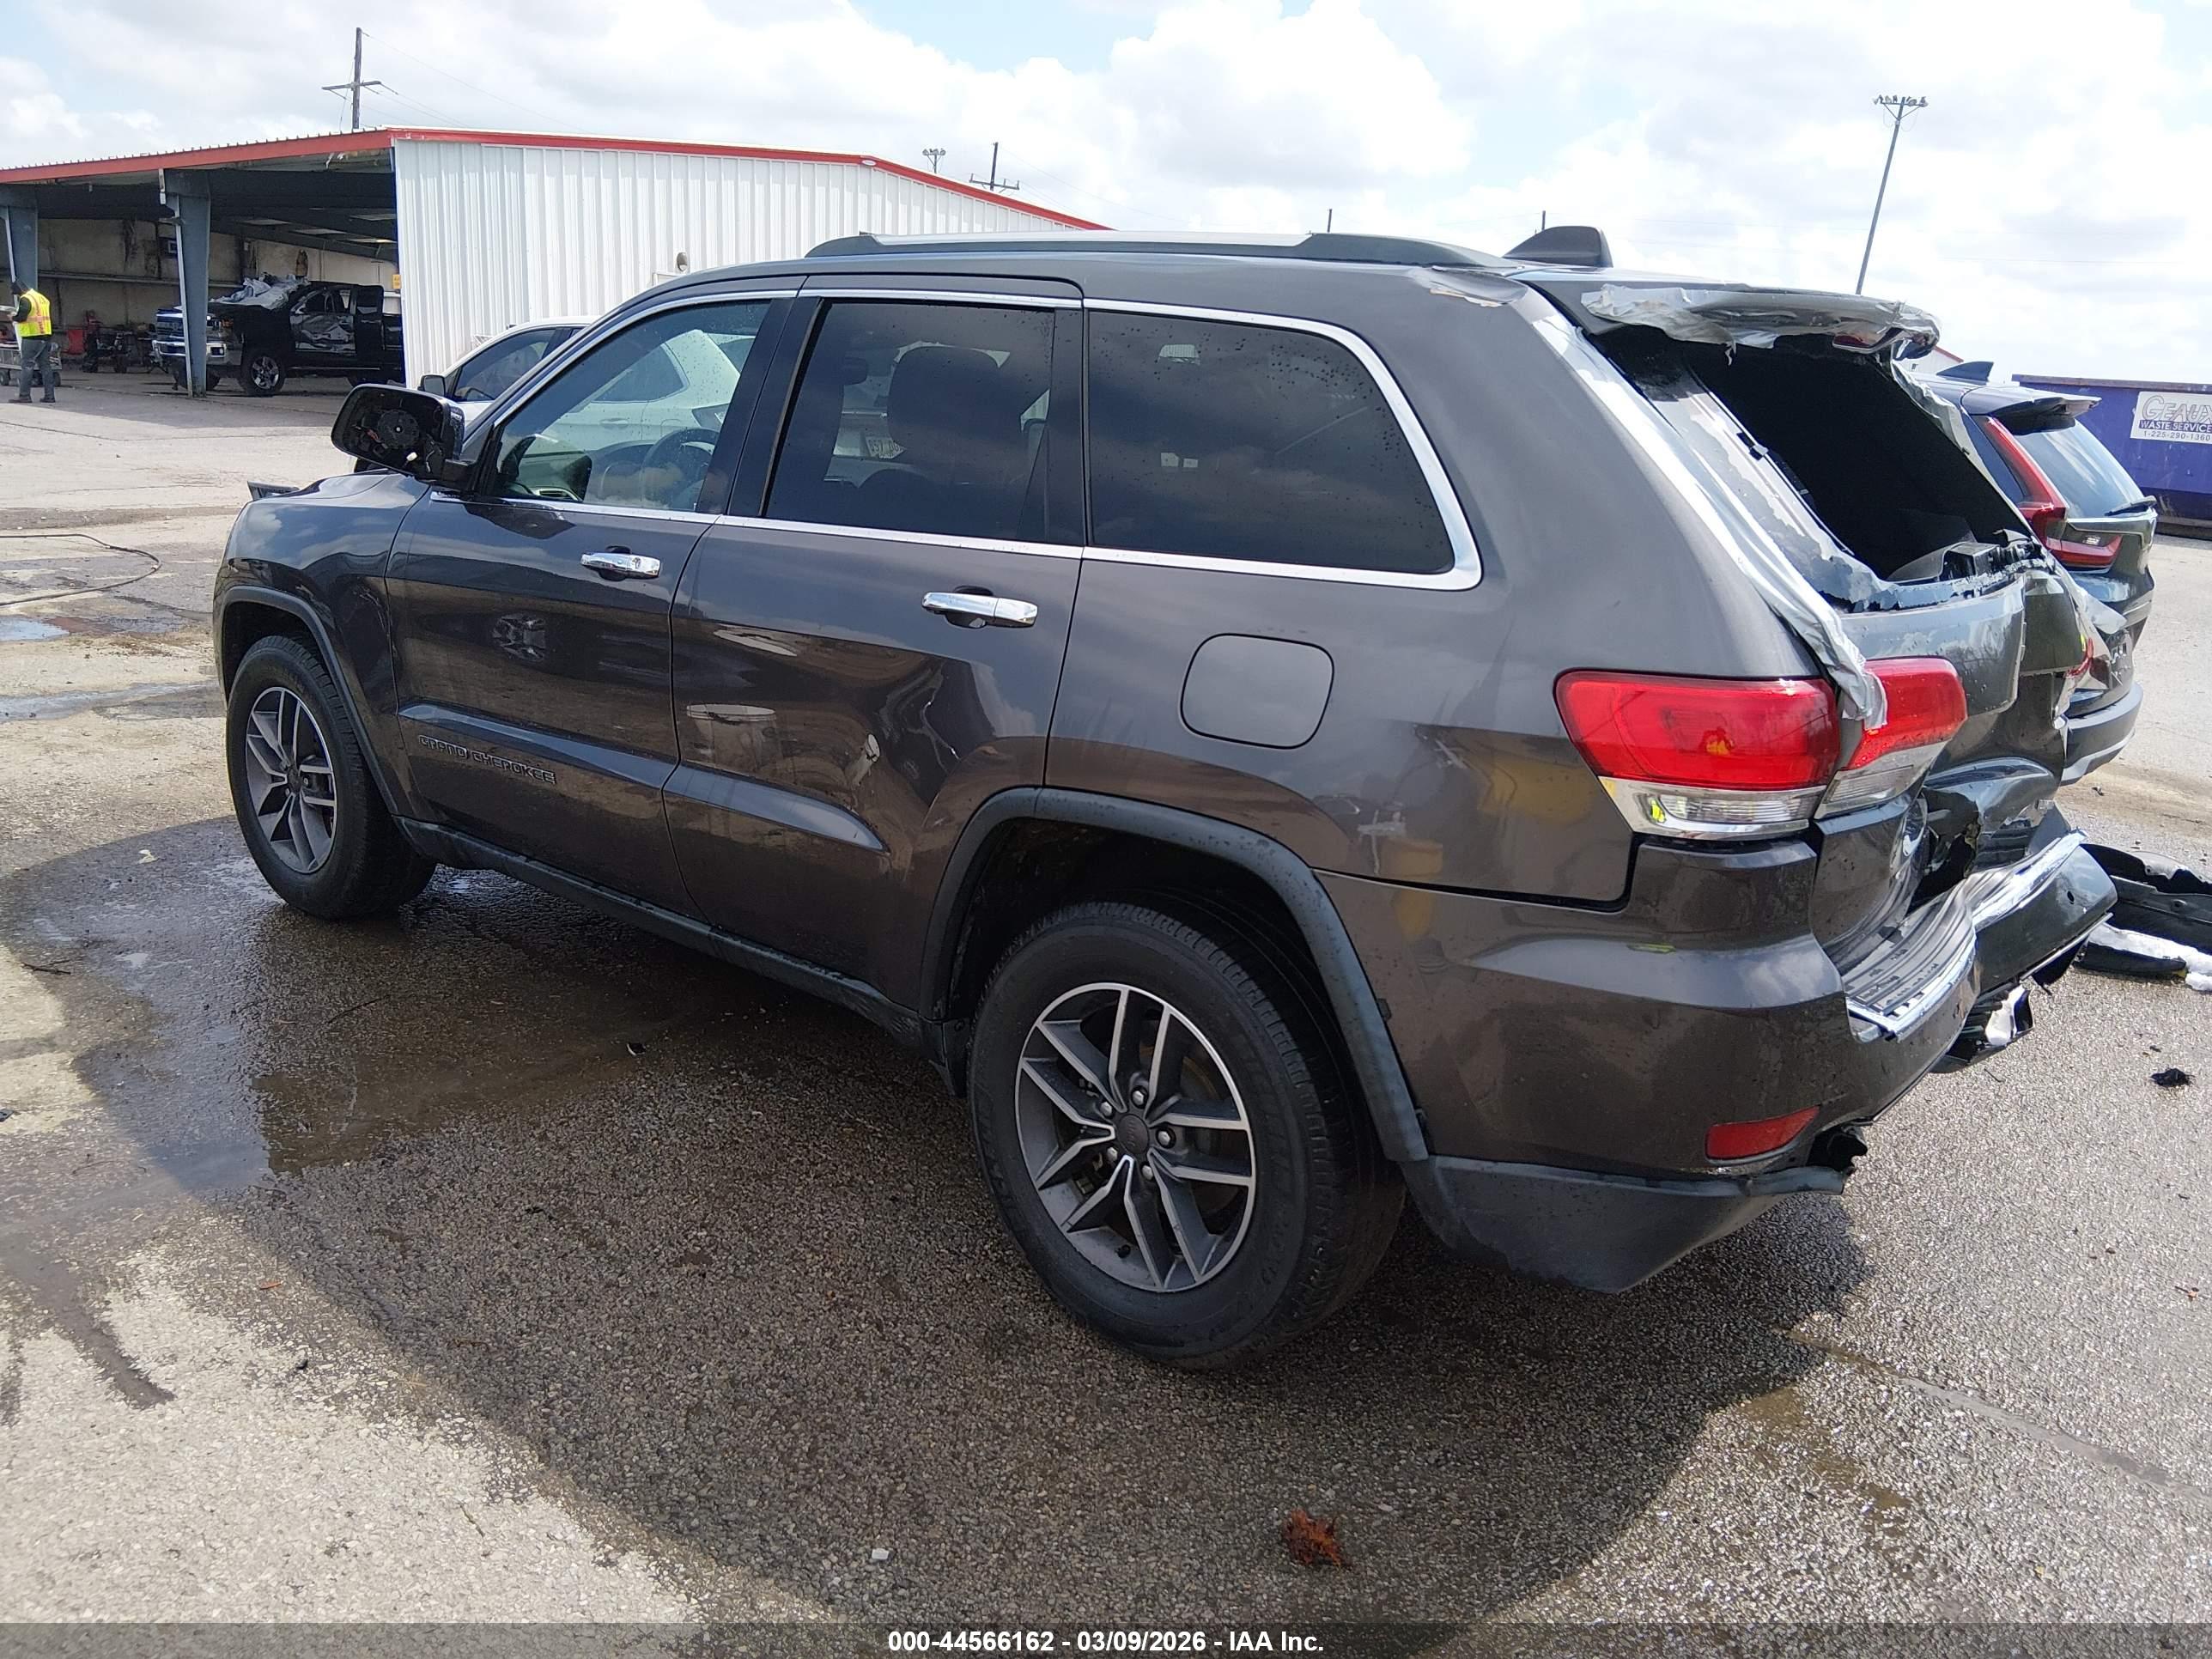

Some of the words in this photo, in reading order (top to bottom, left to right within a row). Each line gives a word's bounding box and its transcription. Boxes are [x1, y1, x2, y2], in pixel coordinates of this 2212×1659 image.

[2142, 395, 2212, 423] GEAUX
[2141, 421, 2171, 430] WASTE
[2143, 431, 2211, 441] 1-225-290-1360
[419, 735, 469, 759] GRAND
[471, 750, 556, 785] CHEROKEE
